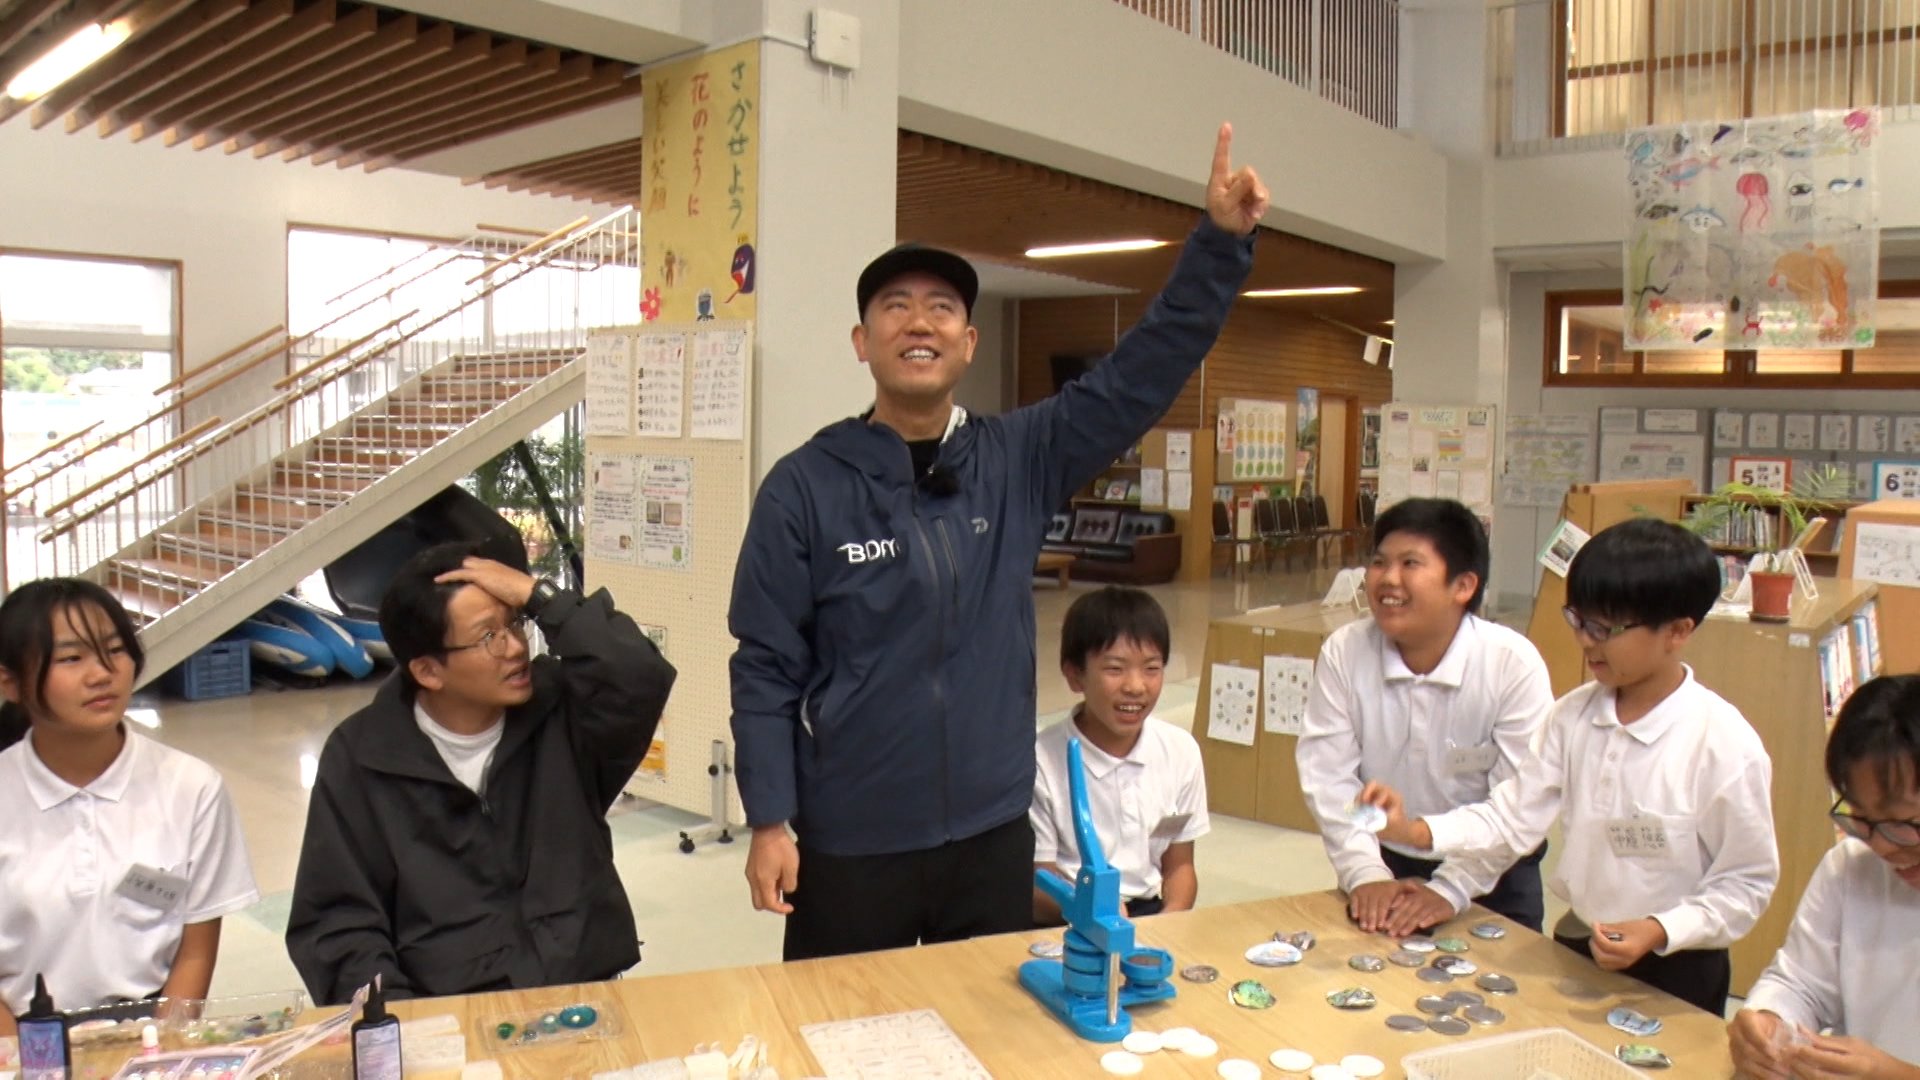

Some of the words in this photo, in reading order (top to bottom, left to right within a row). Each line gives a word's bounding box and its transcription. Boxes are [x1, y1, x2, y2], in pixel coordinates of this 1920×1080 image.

[687, 71, 711, 218] 花のように
[727, 60, 753, 230] さかせよう
[1741, 469, 1754, 486] 5
[1886, 473, 1899, 491] 6
